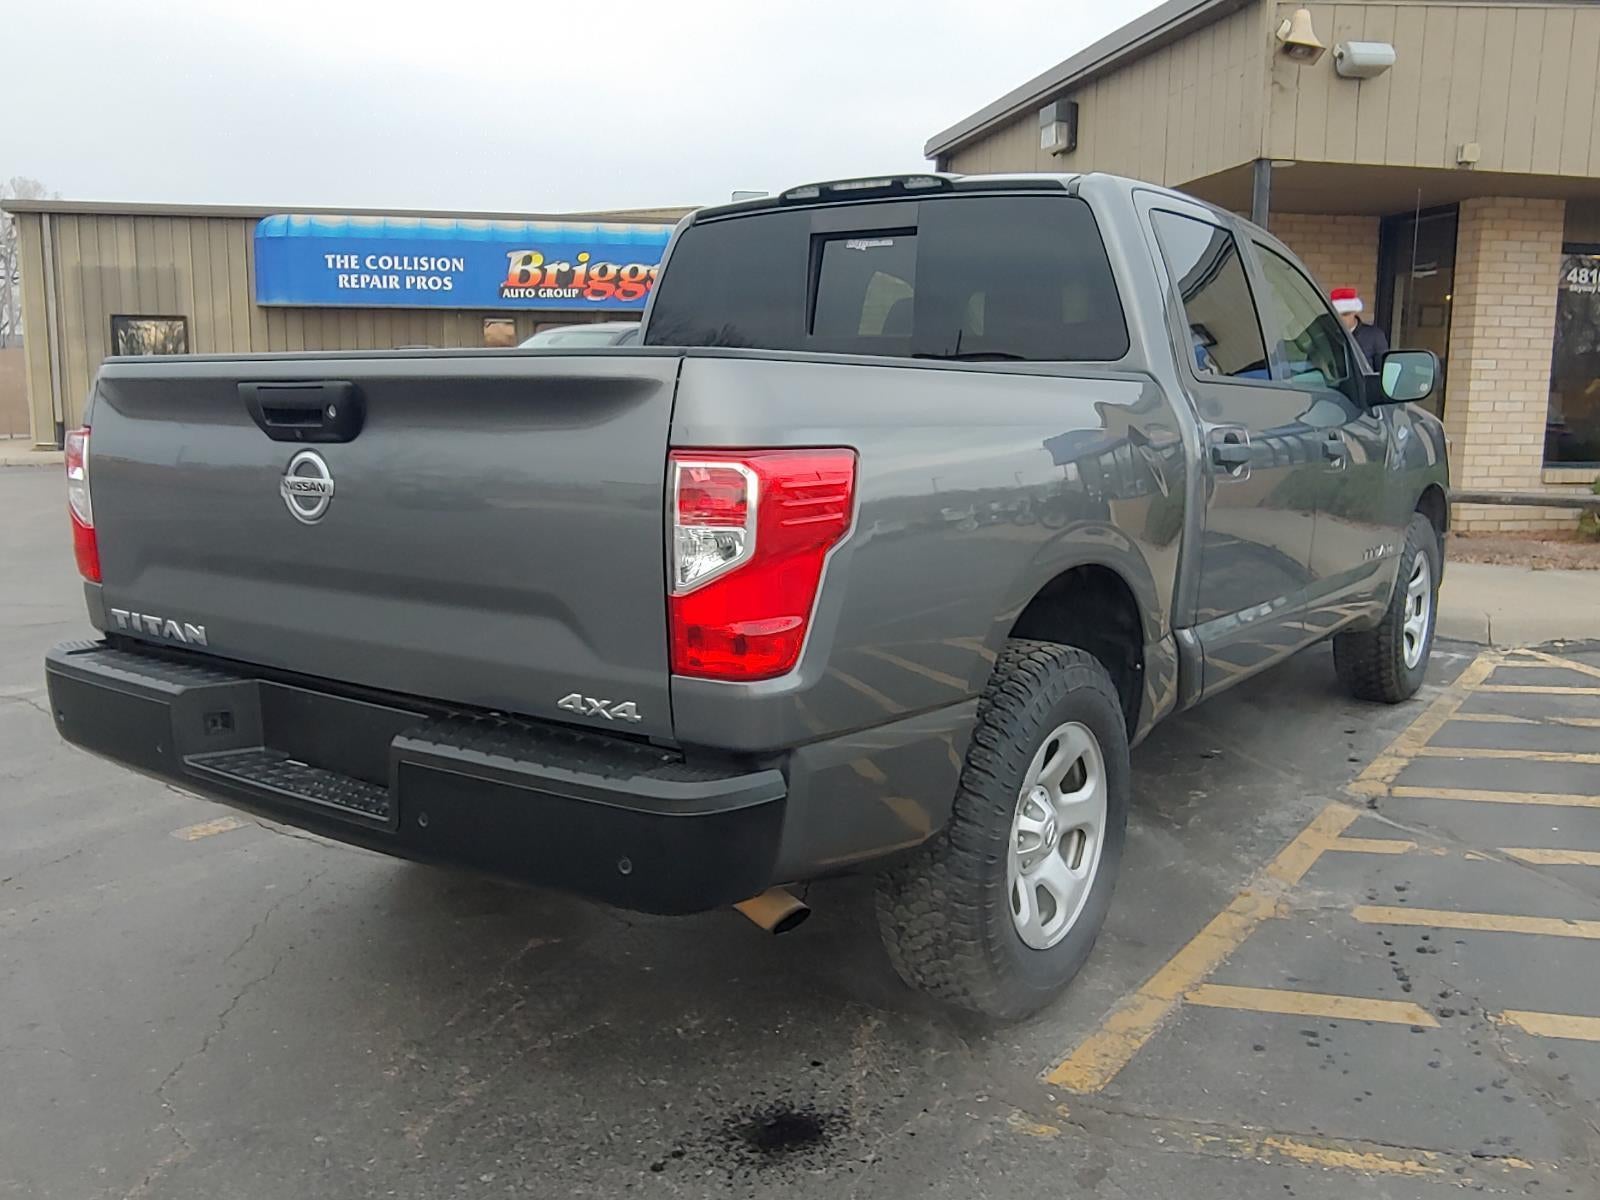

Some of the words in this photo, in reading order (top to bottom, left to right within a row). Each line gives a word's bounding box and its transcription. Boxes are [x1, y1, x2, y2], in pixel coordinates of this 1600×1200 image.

[324, 254, 360, 269] THE
[365, 255, 464, 272] COLLISION
[338, 274, 400, 289] REPAIR
[405, 276, 453, 290] PROS
[502, 288, 535, 298] AUTO
[538, 288, 579, 298] GROUP
[286, 481, 326, 493] NISSAN
[110, 608, 208, 646] TITAN
